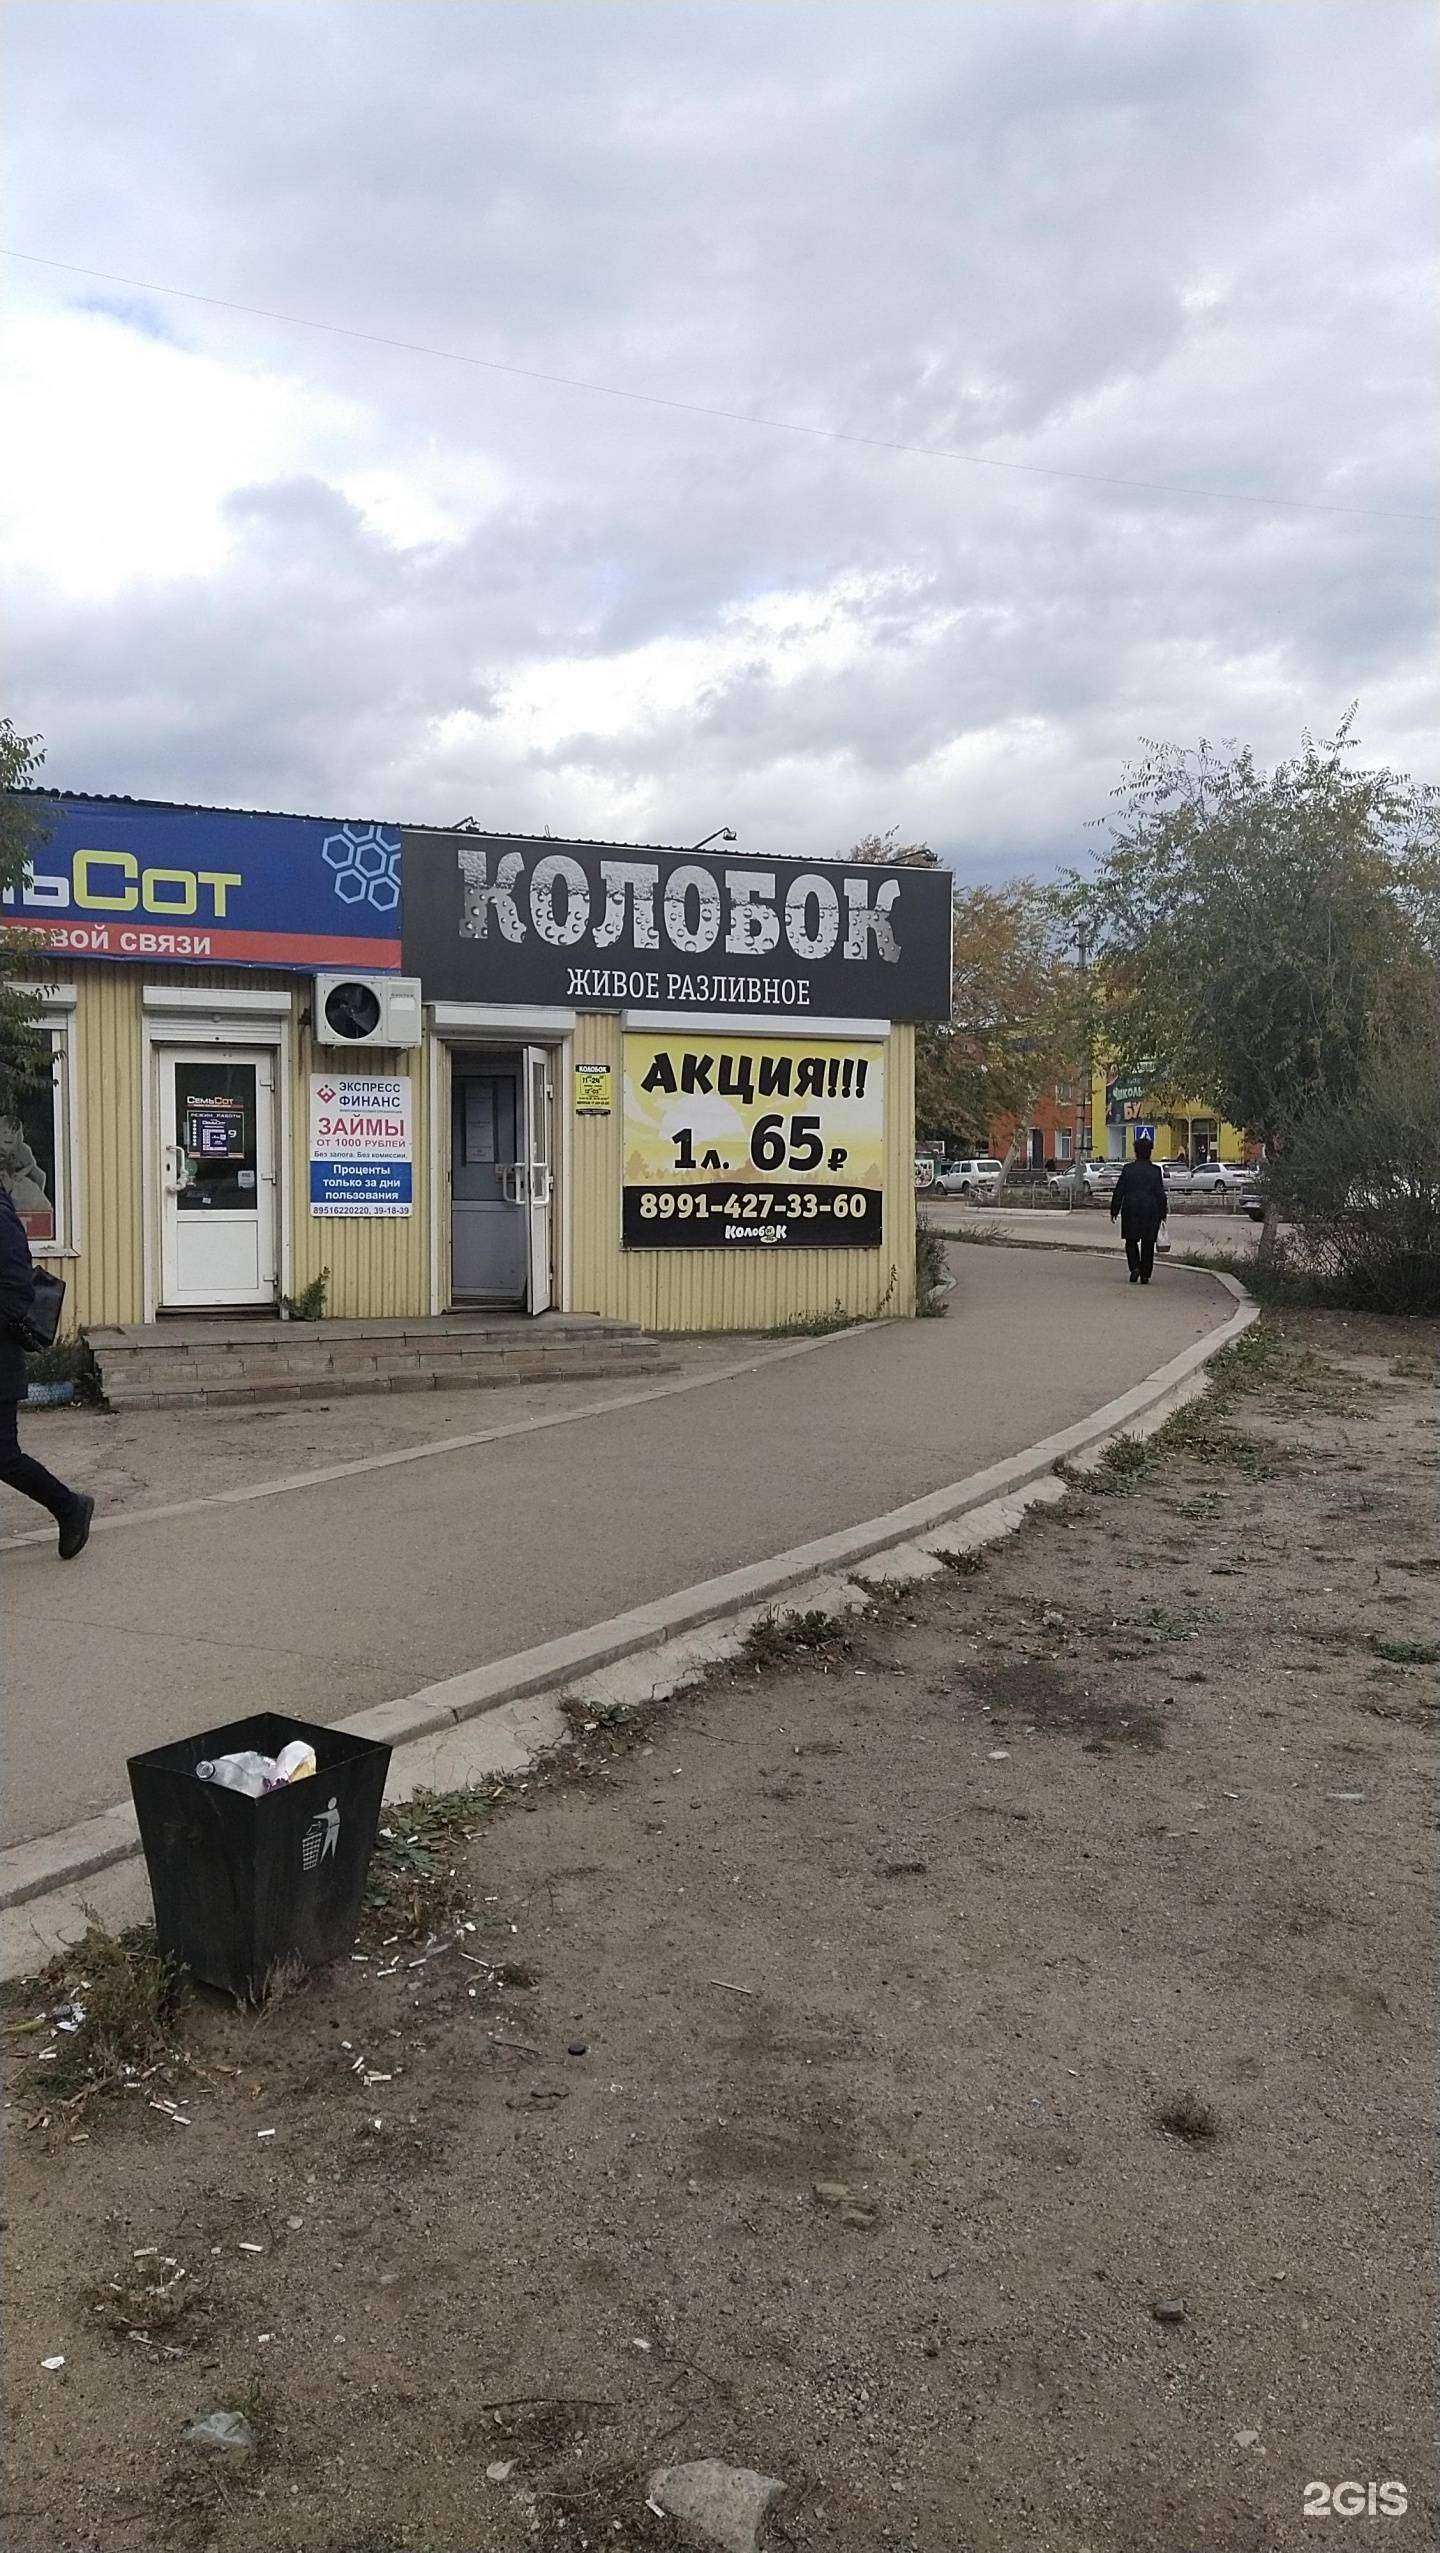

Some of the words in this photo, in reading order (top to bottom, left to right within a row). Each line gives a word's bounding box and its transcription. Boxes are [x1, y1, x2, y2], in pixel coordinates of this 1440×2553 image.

[458, 849, 902, 963] КОЛОБОК
[567, 966, 659, 1000] ЖИВОЕ
[667, 972, 811, 1006] РАЗЛИВНОЕ
[640, 1051, 869, 1105] АКЦИЯ!!!
[339, 1081, 400, 1093] ЭКСПРЕСС
[339, 1096, 401, 1108] ФИНАНС
[318, 1113, 404, 1137] ЗАЙМЫ
[316, 1139, 330, 1147] ОТ
[335, 1138, 361, 1147] 1000
[365, 1139, 406, 1148] РУБЛЕЙ
[333, 1164, 391, 1175] Проценты
[323, 1178, 362, 1187] только
[364, 1179, 377, 1187] за
[379, 1179, 400, 1189] дни
[325, 1191, 399, 1200] пользования
[373, 1207, 410, 1215] 39-18-39
[640, 1192, 867, 1220] 8991-427-33-60
